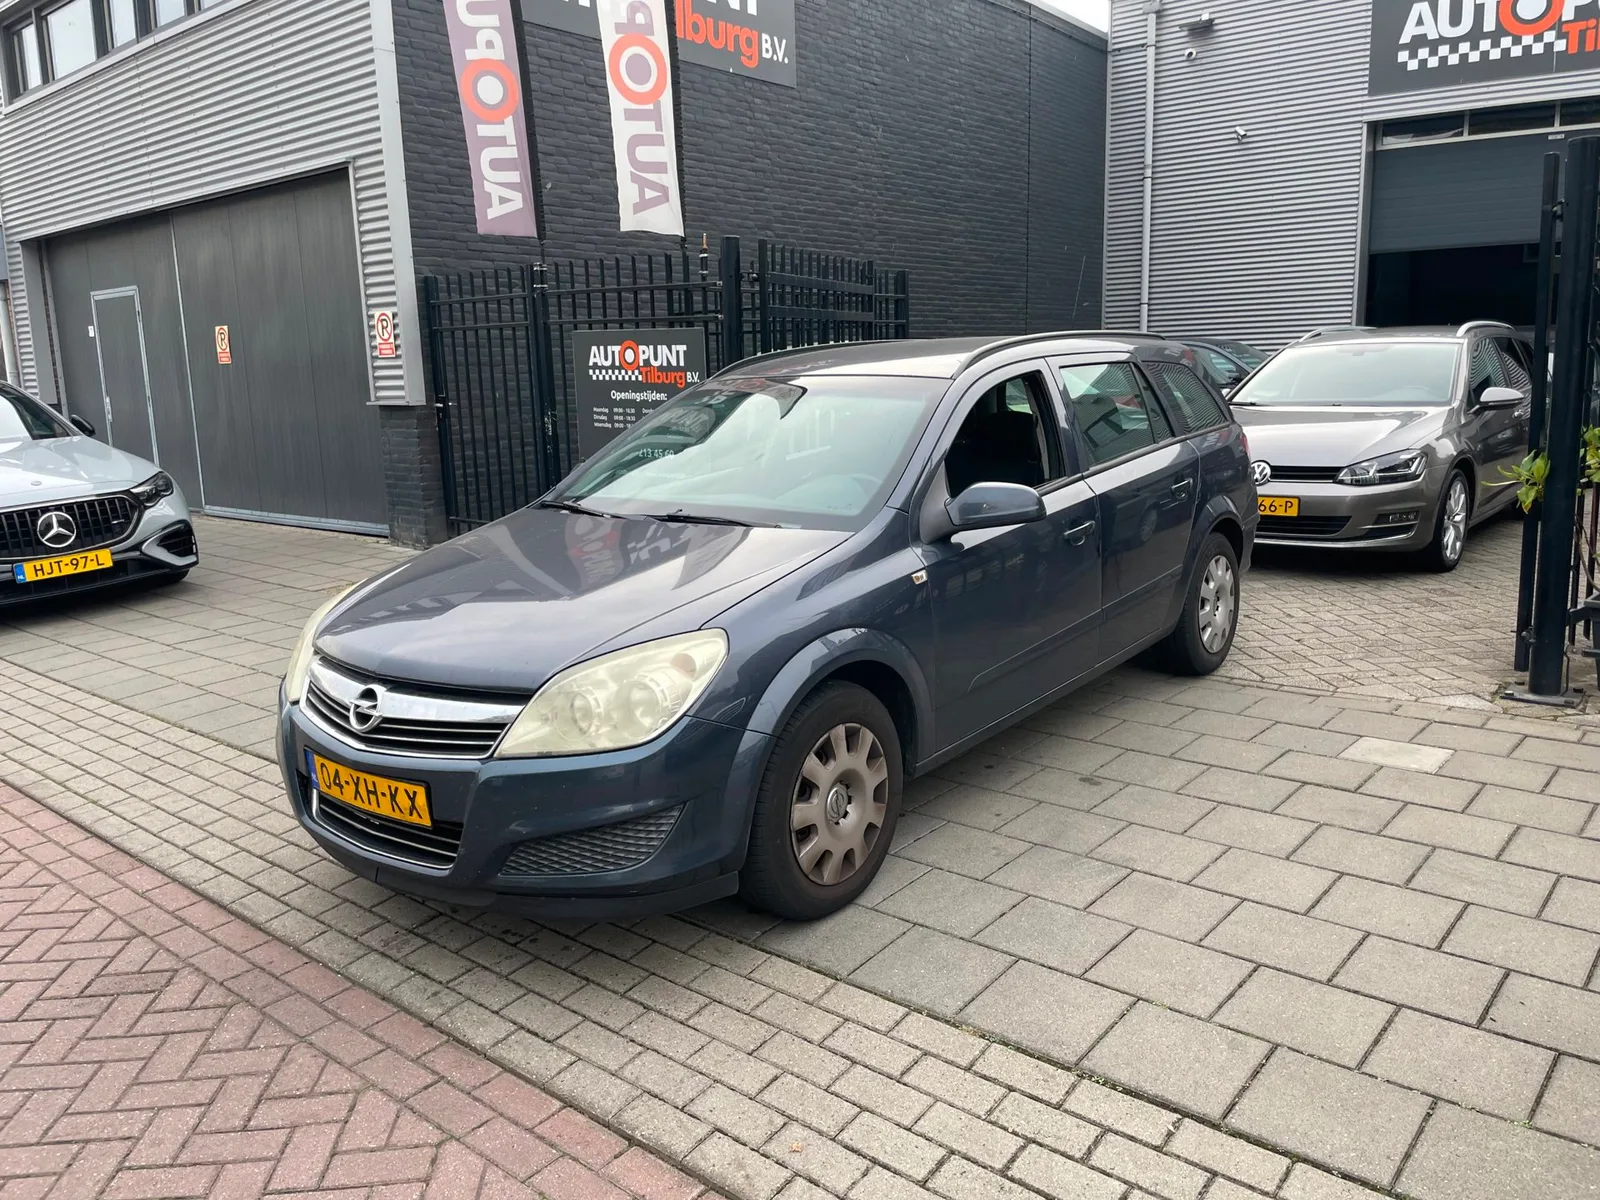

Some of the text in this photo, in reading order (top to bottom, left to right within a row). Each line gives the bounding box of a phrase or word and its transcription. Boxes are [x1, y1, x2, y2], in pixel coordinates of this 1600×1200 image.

[674, 0, 789, 68] lburg B.V.
[1398, 0, 1600, 45] AUTOP
[588, 340, 687, 371] AUTOPUNT
[640, 366, 700, 388] Tilburg B.V.
[610, 389, 668, 402] Openingstijden:
[33, 554, 105, 578] HJT-97-L
[320, 762, 423, 820] 04-XH-KX
